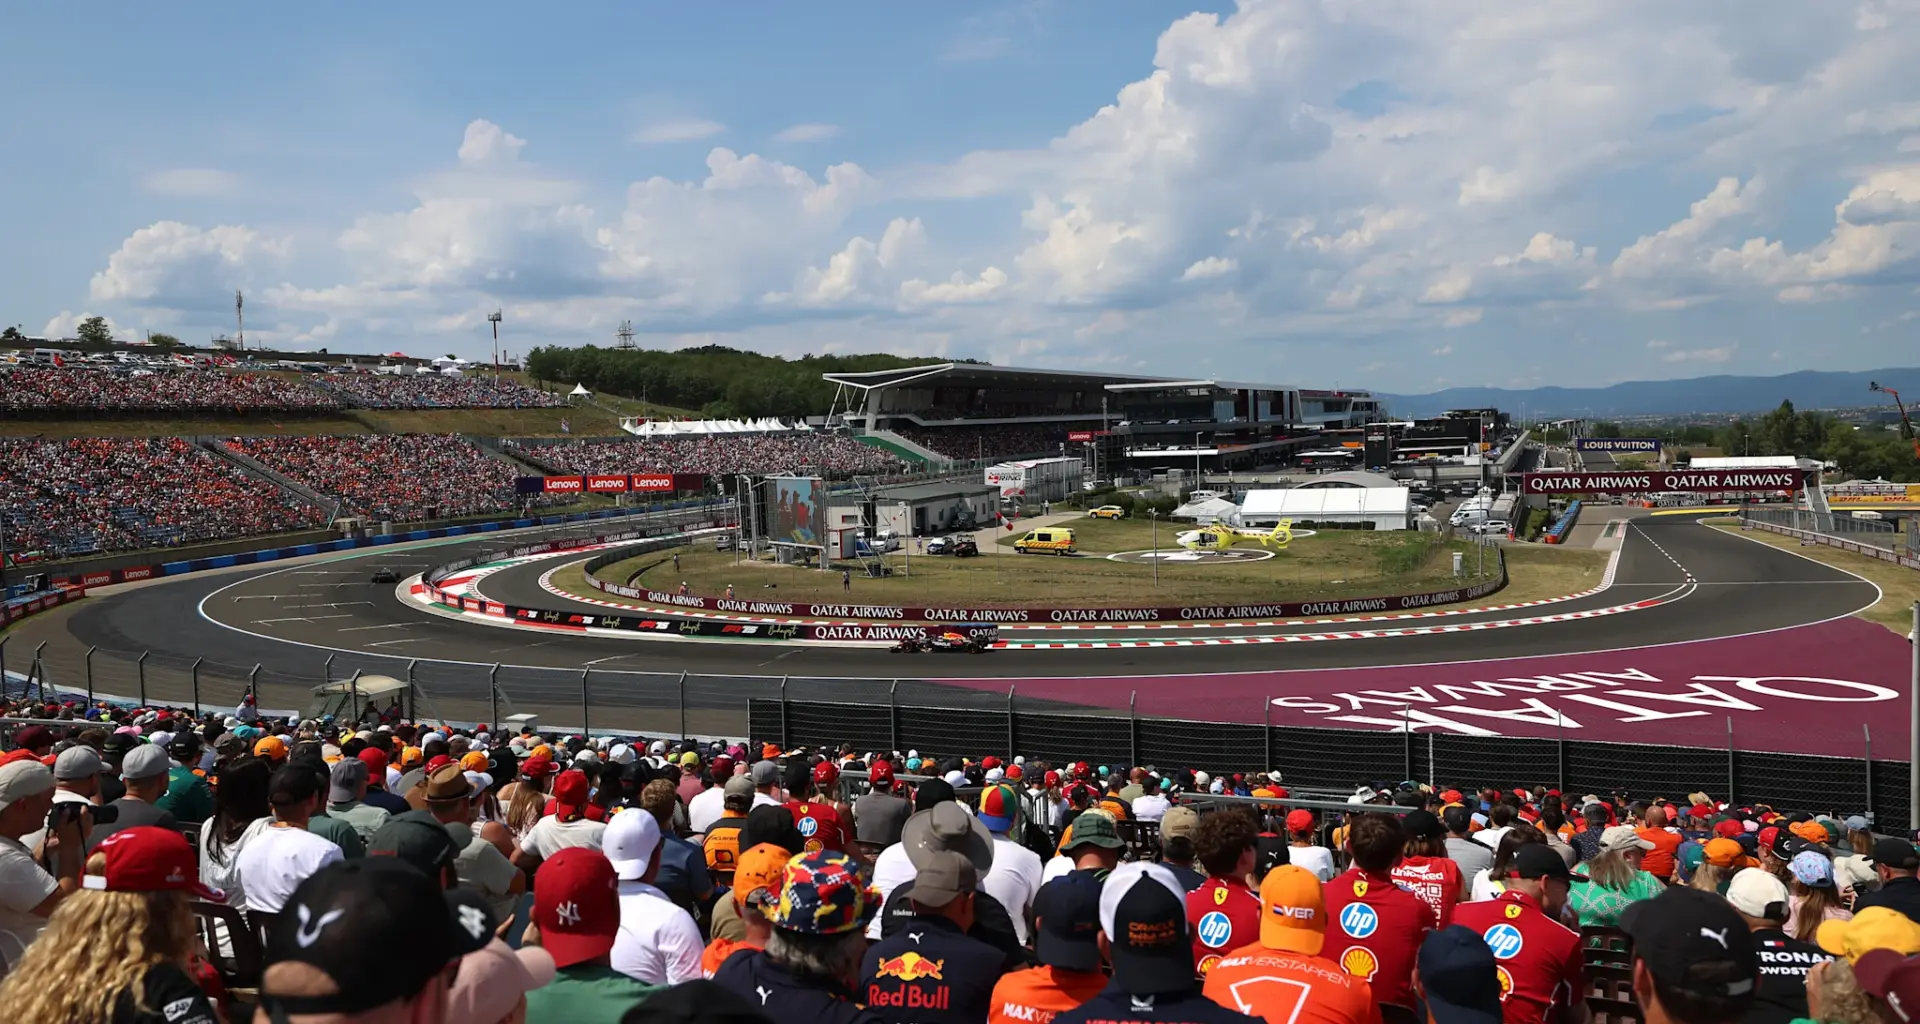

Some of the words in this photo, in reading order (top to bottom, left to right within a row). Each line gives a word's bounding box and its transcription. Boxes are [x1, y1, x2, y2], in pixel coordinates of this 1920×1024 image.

[1584, 441, 1612, 449] LOUIS
[1614, 441, 1655, 449] VUITTON
[546, 480, 580, 489] Lenovo
[590, 479, 624, 488] Lenovo
[634, 478, 670, 487] Lenovo
[1530, 477, 1582, 491] QATAR
[1584, 475, 1650, 490] AIRWAYS
[1664, 474, 1718, 489] QATAR
[1721, 473, 1793, 488] AIRWAYS
[84, 574, 110, 585] Lenovo
[125, 568, 150, 580] Lenovo
[604, 582, 618, 594] QATAR
[648, 592, 670, 603] QATAR
[671, 594, 704, 608] AIRWAYS
[1401, 596, 1429, 608] QATAR
[1430, 590, 1460, 604] AIRWAYS
[487, 604, 504, 614] Lenovo
[717, 600, 747, 612] QATAR
[750, 602, 793, 614] AIRWAYS
[810, 605, 849, 616] QATAR
[851, 606, 904, 619] AIRWAYS
[1181, 607, 1226, 620] QATAR
[1228, 605, 1282, 618] AIRWAYS
[1301, 602, 1340, 616] QATAR
[1342, 599, 1387, 612] AIRWAYS
[924, 608, 967, 621] QATAR
[970, 610, 1028, 621] AIRWAYS
[1051, 610, 1097, 621] QATAR
[1100, 609, 1158, 620] AIRWAYS
[815, 626, 862, 639] QATAR
[866, 627, 926, 640] AIRWAYS
[1283, 906, 1314, 919] VER
[1345, 902, 1374, 938] hp
[1202, 912, 1228, 947] hp
[1488, 924, 1518, 958] hp
[1756, 951, 1835, 963] RONAS
[868, 984, 904, 1007] Red
[908, 986, 950, 1010] Bull
[166, 1002, 189, 1018] SAP
